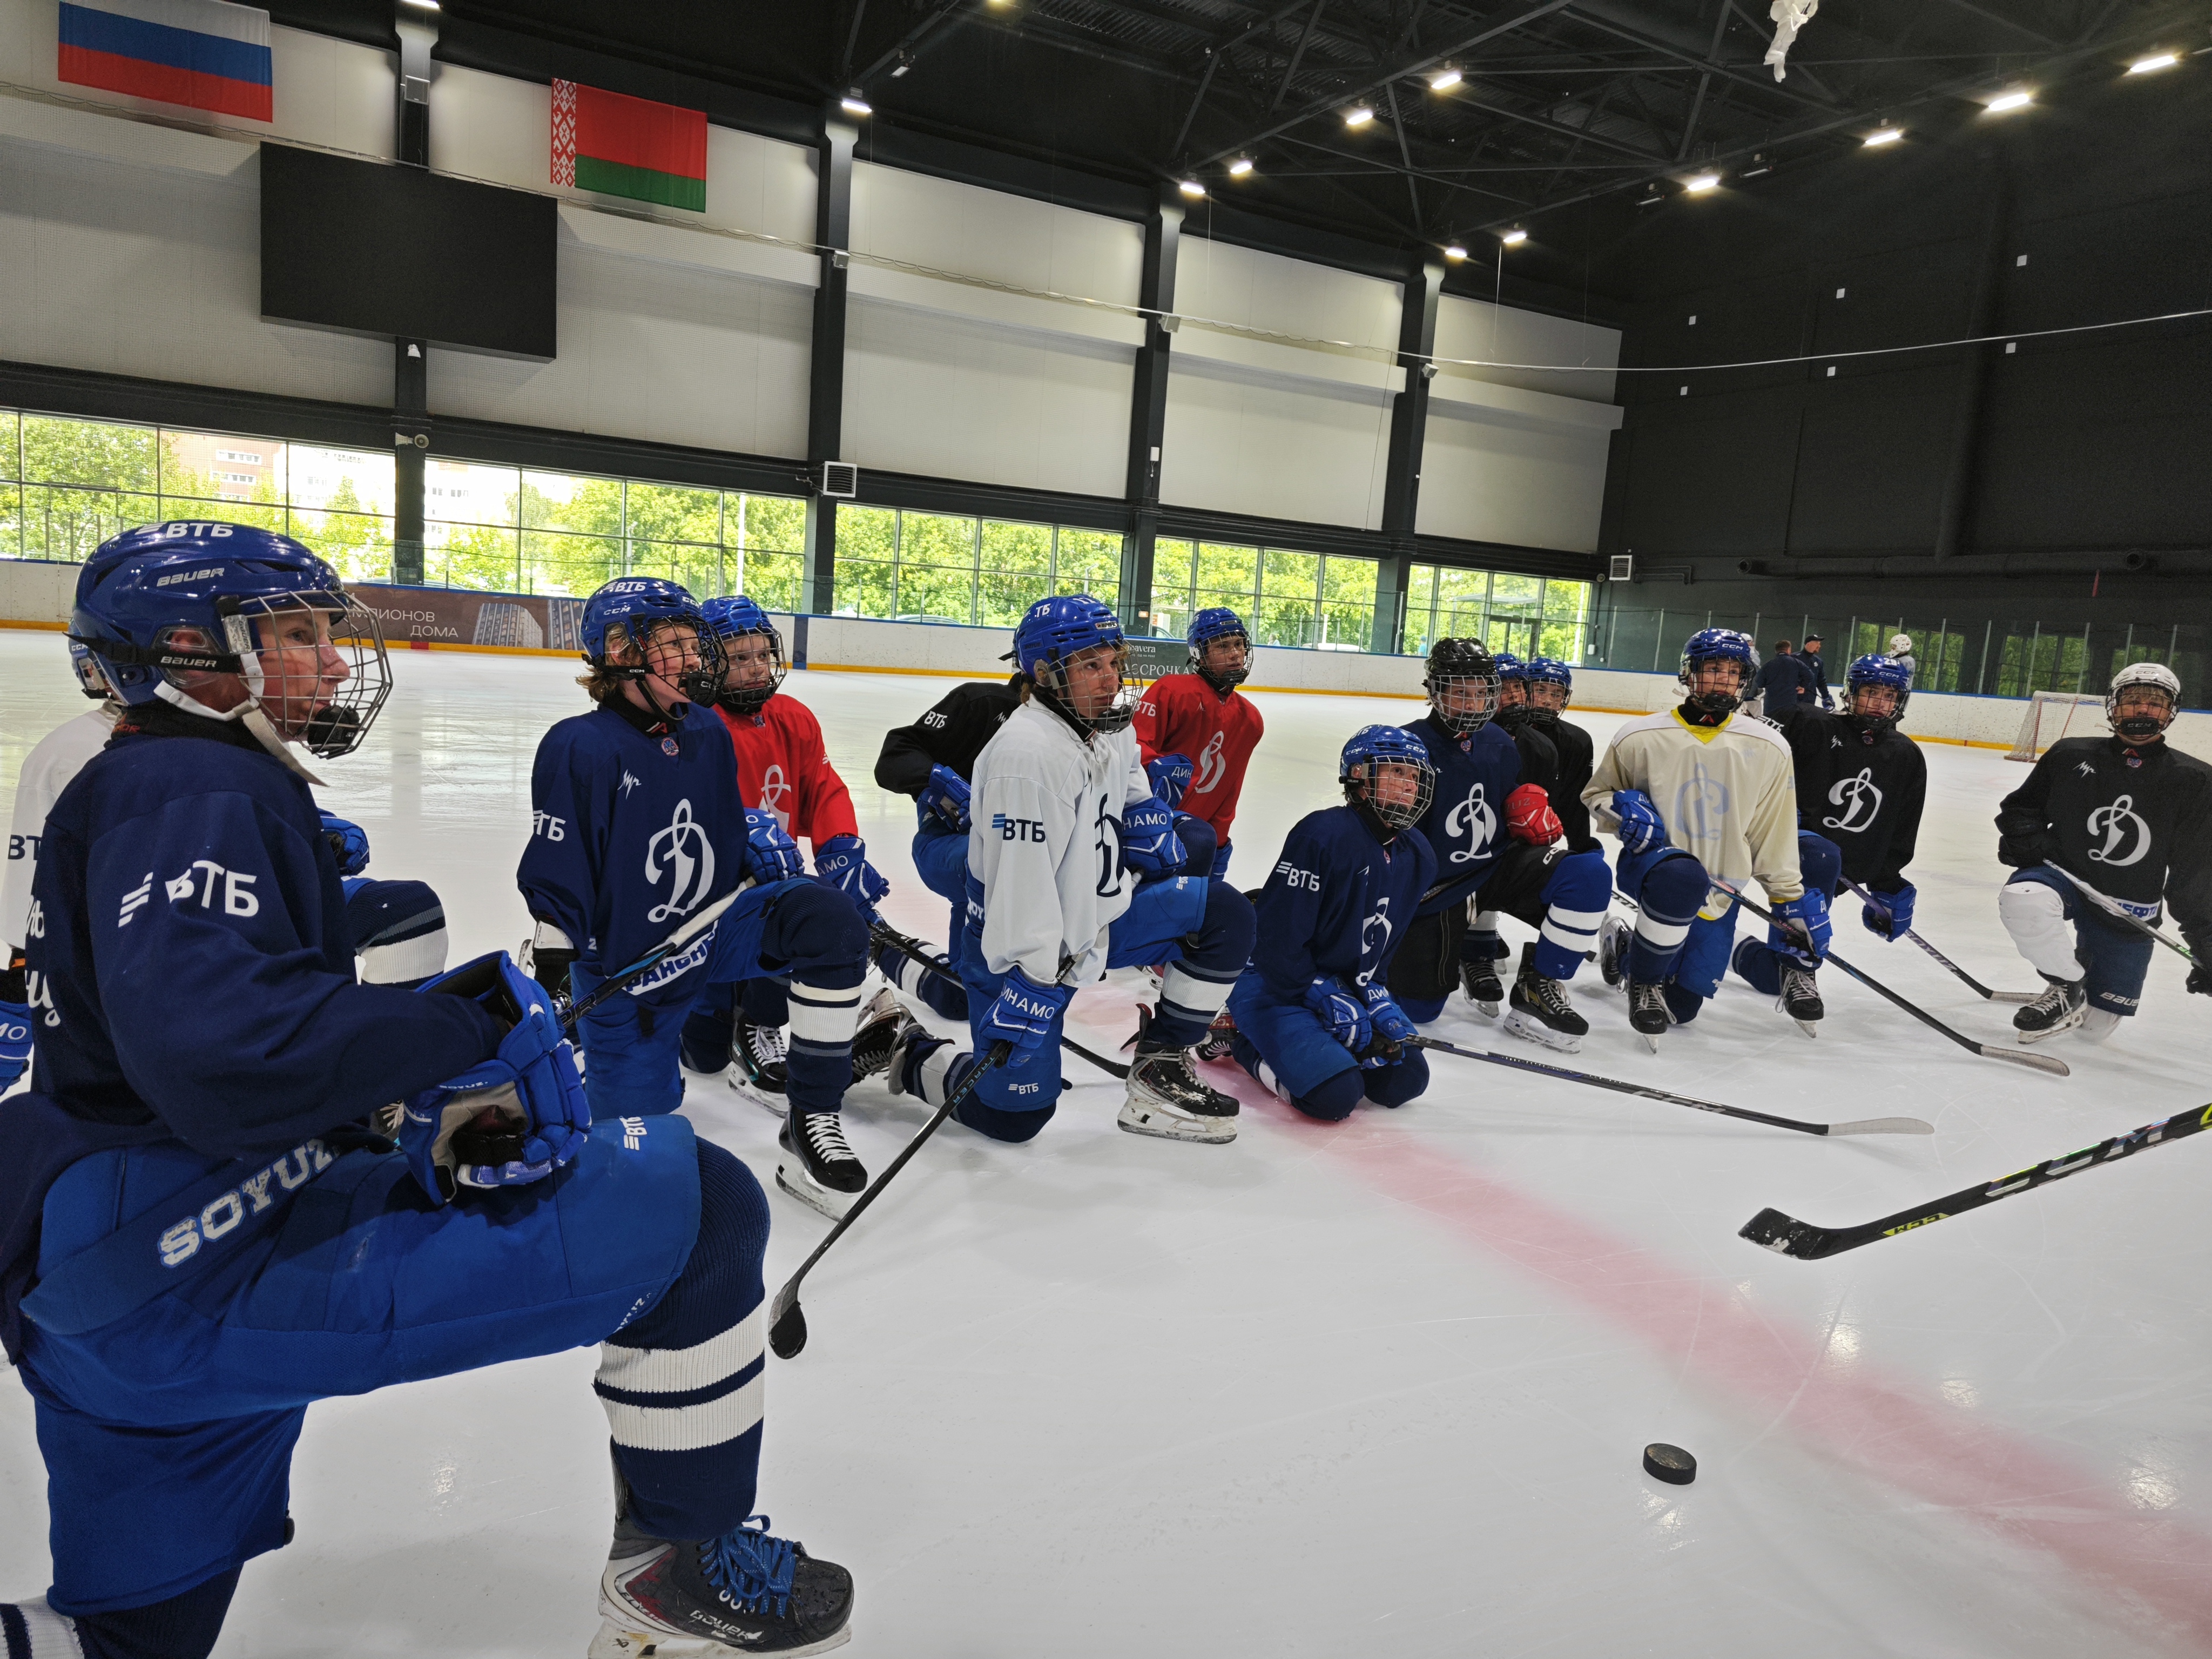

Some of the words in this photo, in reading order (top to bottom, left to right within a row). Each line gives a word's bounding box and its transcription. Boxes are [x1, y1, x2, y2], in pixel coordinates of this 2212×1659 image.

[166, 523, 233, 538] ВТБ
[157, 568, 225, 586] BAUER
[615, 581, 647, 592] ВТБ
[347, 608, 435, 622] МПИОНОВ
[603, 606, 631, 615] CCM
[410, 625, 458, 638] ДОМА
[160, 656, 217, 667] BAUER
[1125, 663, 1188, 676] АССРОЧКА
[1883, 657, 1898, 666] 29
[1135, 700, 1157, 718] ВТБ
[924, 710, 947, 729] ВТБ
[1406, 744, 1426, 754] CCM
[536, 811, 566, 842] ТБ
[1003, 818, 1046, 843] ВТБ
[1123, 813, 1168, 831] НАМО
[8, 834, 42, 861] ВТ
[1543, 847, 1561, 865] CC
[817, 855, 848, 878] АМО
[1287, 867, 1320, 892] ВТБ
[165, 860, 260, 918] ВТБ
[868, 928, 908, 953] AUER
[1904, 929, 1958, 971] SOYUZ
[2099, 992, 2140, 1007] BAUE
[953, 1056, 995, 1104] TRACER
[1019, 1083, 1039, 1095] ВТБ
[1893, 1213, 1942, 1235] CCM
